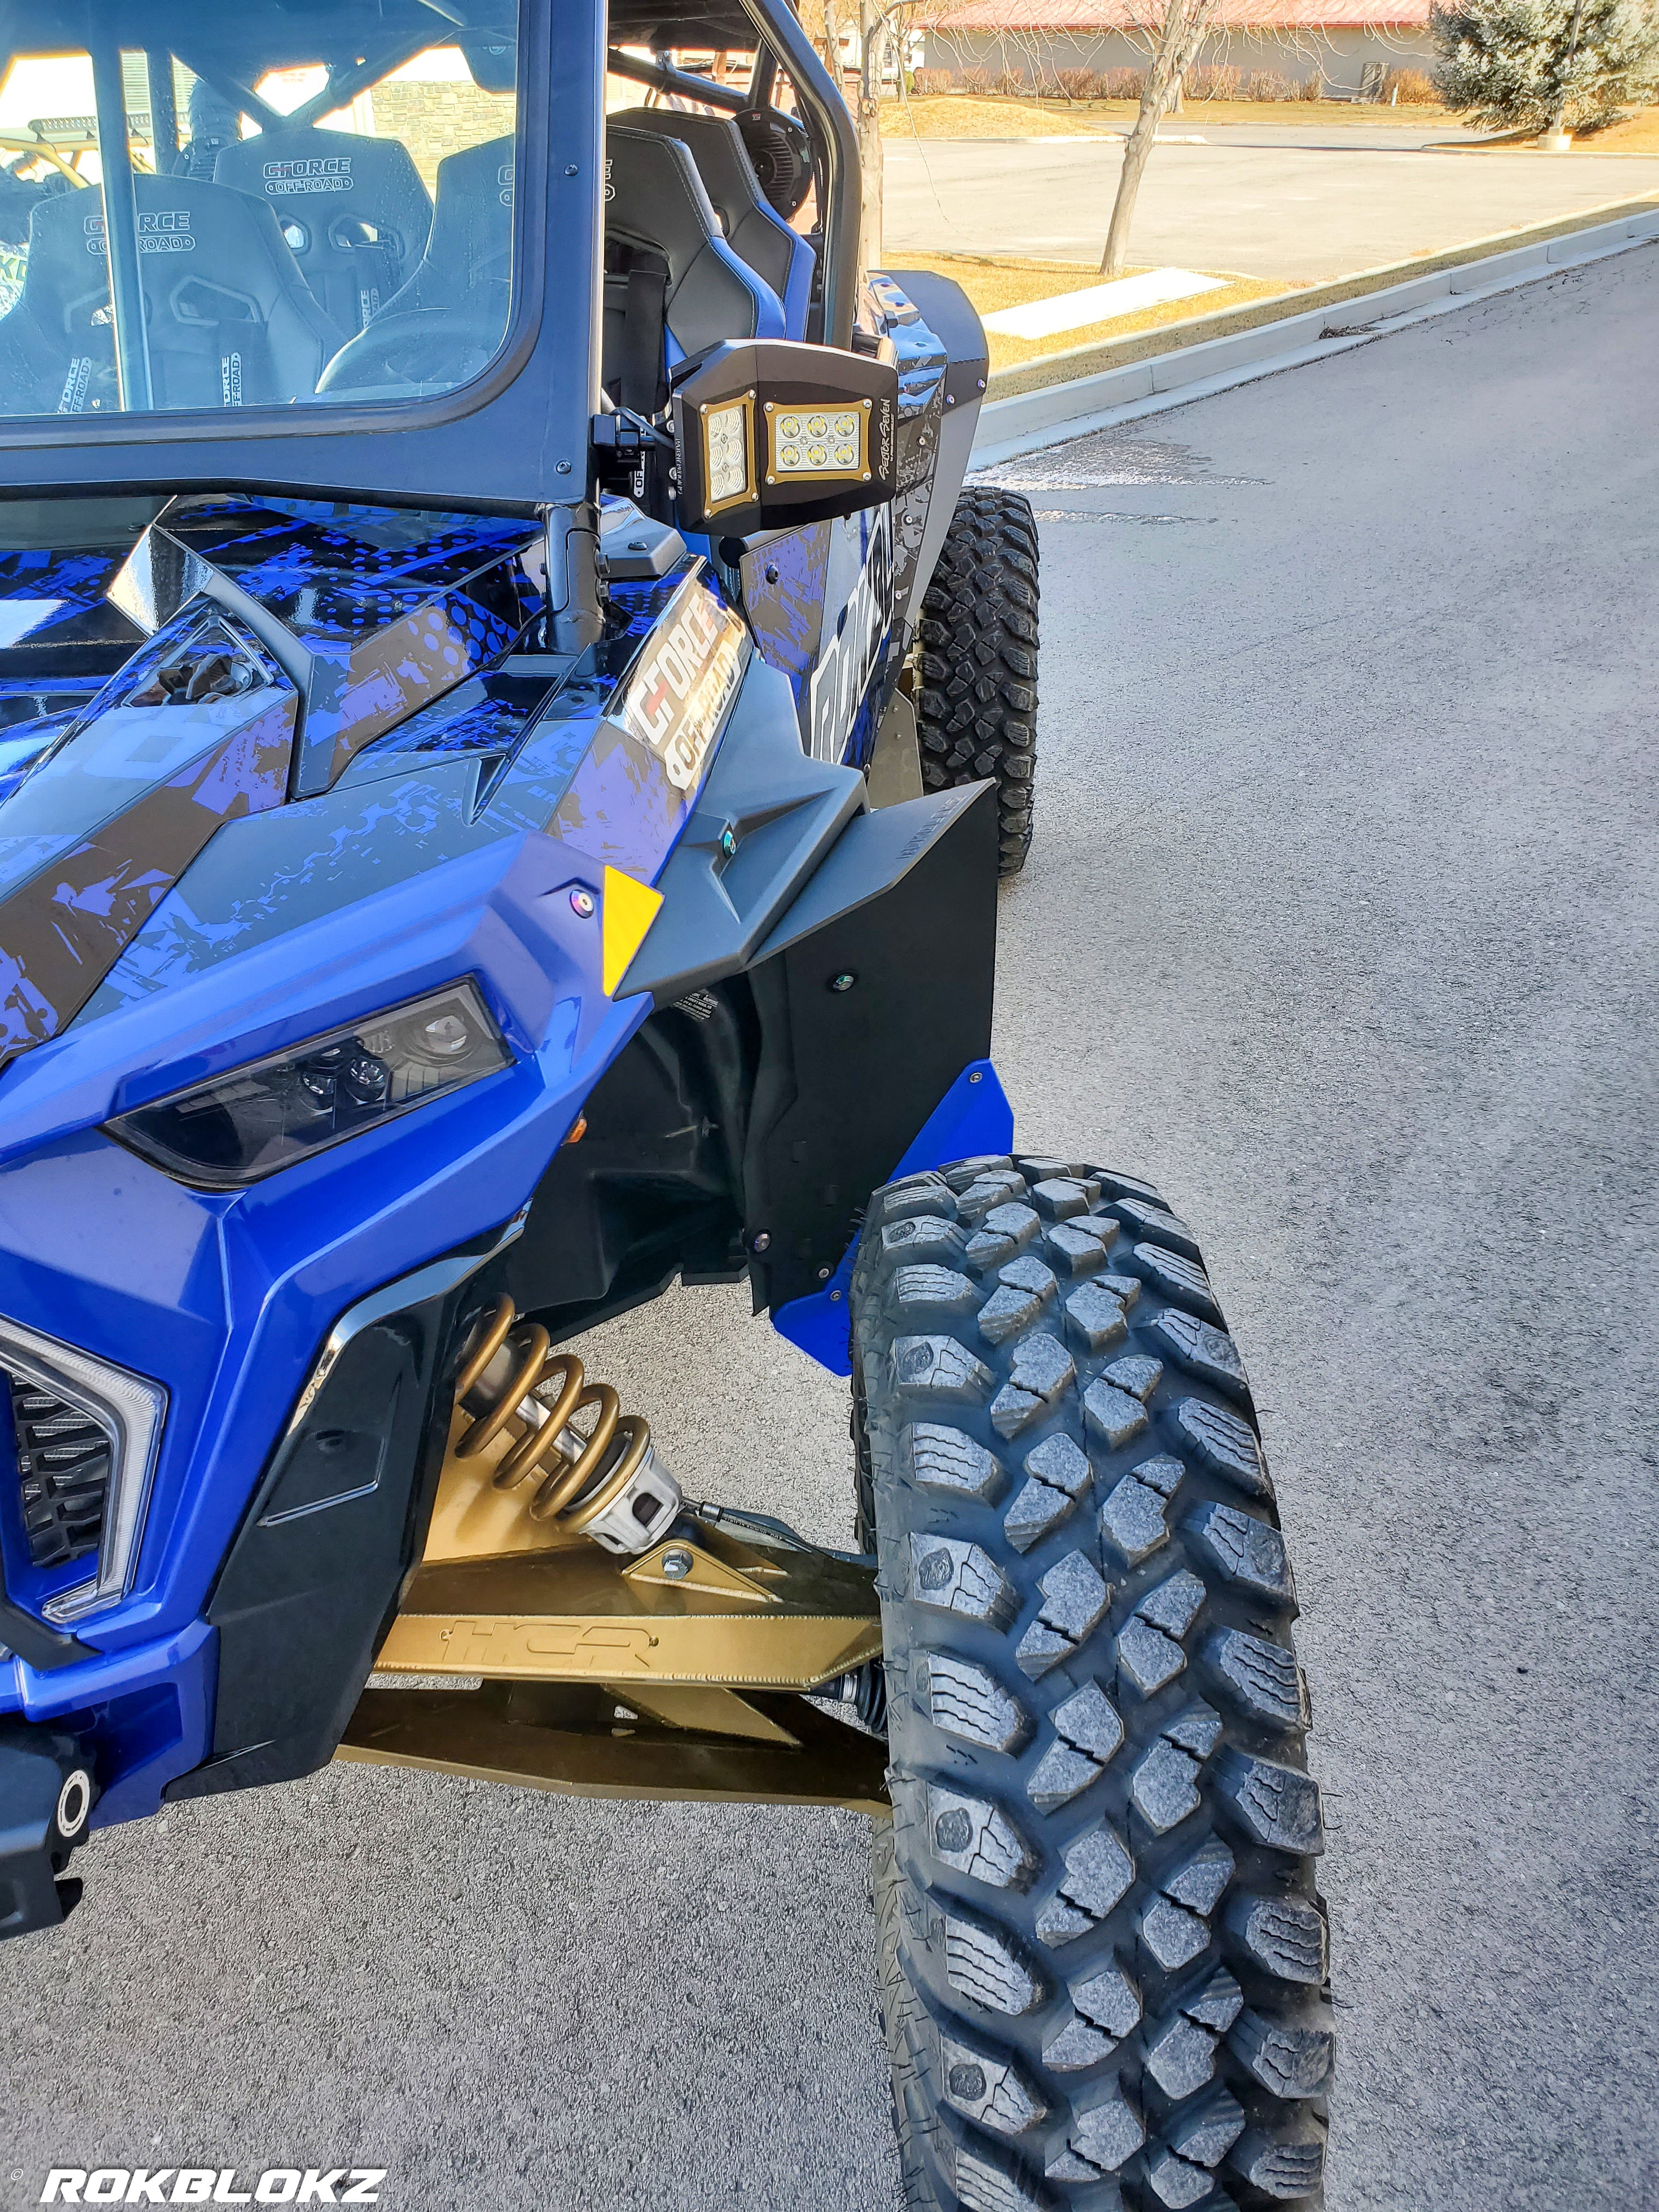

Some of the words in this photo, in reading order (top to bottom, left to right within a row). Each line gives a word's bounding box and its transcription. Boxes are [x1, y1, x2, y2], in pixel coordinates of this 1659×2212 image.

[84, 212, 190, 235] GRCE
[72, 365, 89, 413] FF-ROAD
[879, 398, 890, 438] SEVEN
[879, 438, 890, 481] SECTOR
